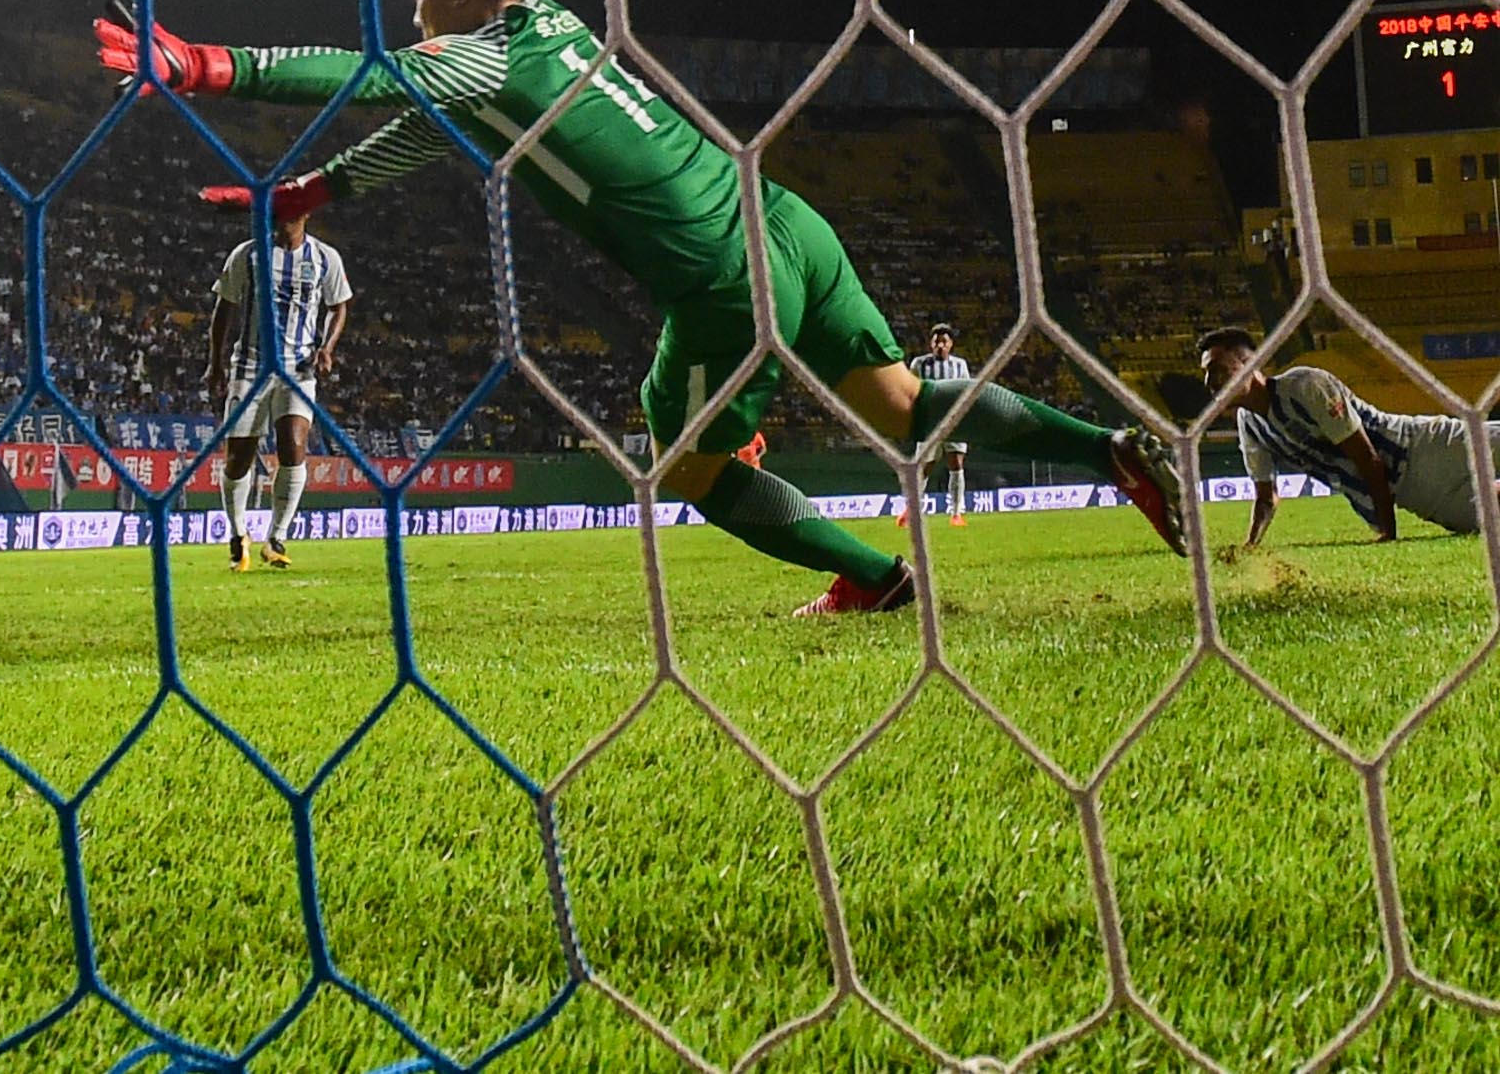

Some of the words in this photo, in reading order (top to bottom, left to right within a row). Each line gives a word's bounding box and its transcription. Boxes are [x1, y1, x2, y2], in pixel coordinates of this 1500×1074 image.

[1403, 37, 1474, 60] 广州富力
[1442, 71, 1454, 97] 1
